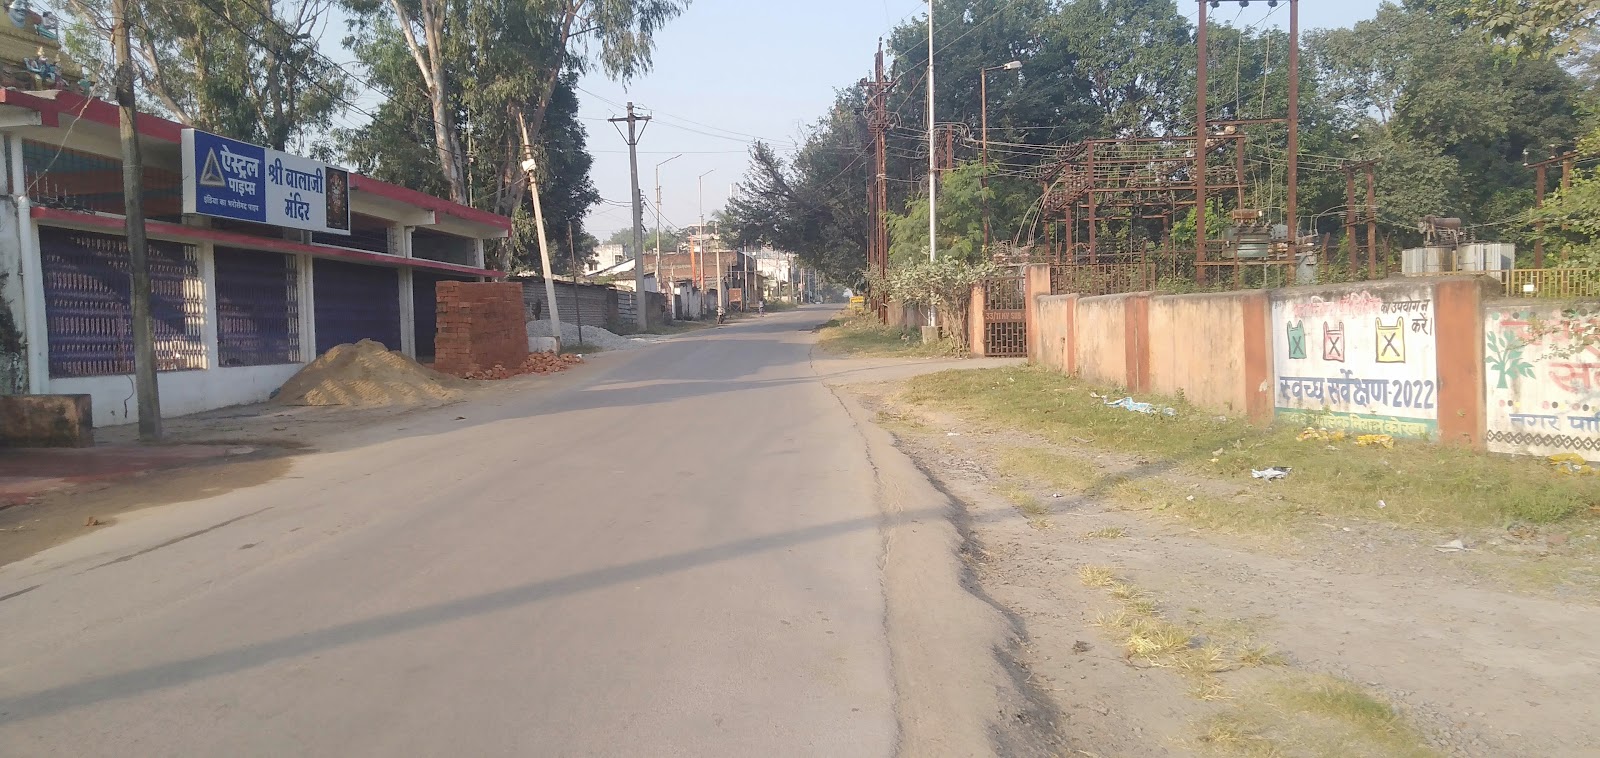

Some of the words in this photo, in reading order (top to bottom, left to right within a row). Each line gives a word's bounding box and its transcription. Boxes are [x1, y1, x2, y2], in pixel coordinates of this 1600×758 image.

[268, 157, 283, 186] श्री
[285, 167, 324, 194] बालाजी
[228, 177, 256, 197] पाइप्स
[219, 198, 227, 206] का
[284, 192, 310, 221] मंदिर
[1391, 294, 1421, 313] उपयोग
